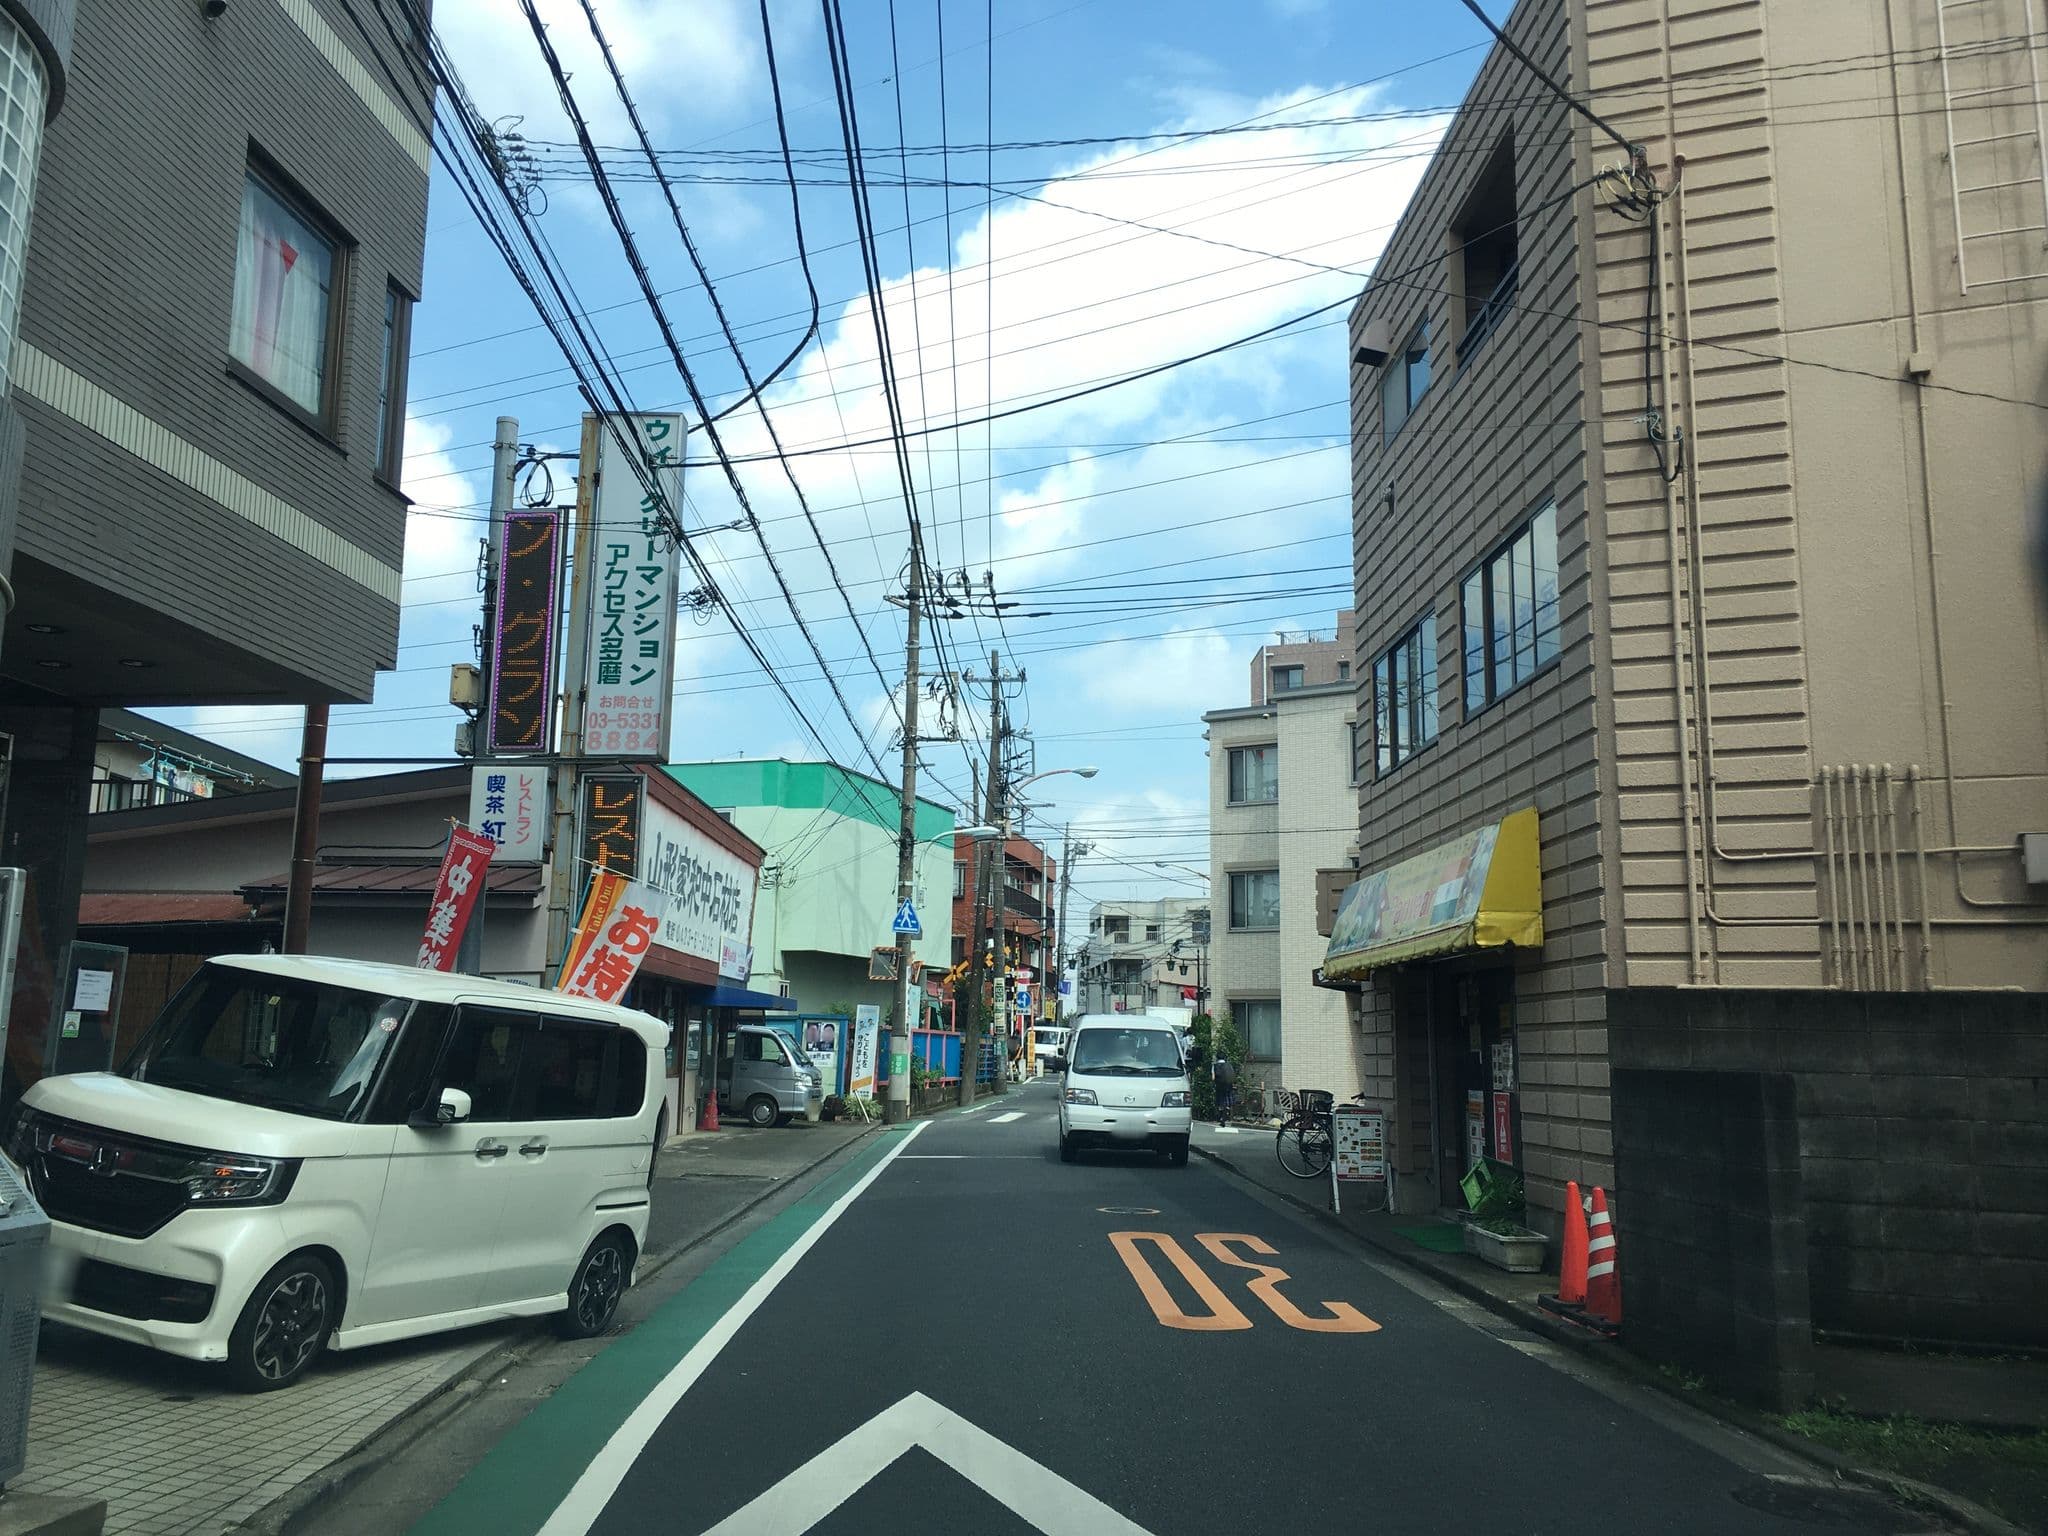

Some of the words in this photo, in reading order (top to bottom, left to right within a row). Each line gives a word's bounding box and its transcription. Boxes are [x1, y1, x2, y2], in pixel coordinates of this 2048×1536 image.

[597, 544, 630, 685] アクセス多磨
[588, 712, 660, 729] 03-5331
[599, 695, 655, 709] お問合せ
[587, 730, 658, 750] 8884
[515, 773, 533, 844] レストラン
[587, 907, 607, 934] Take
[601, 884, 613, 905] Out
[567, 904, 659, 1002] お持
[1107, 1231, 1382, 1333] 30
